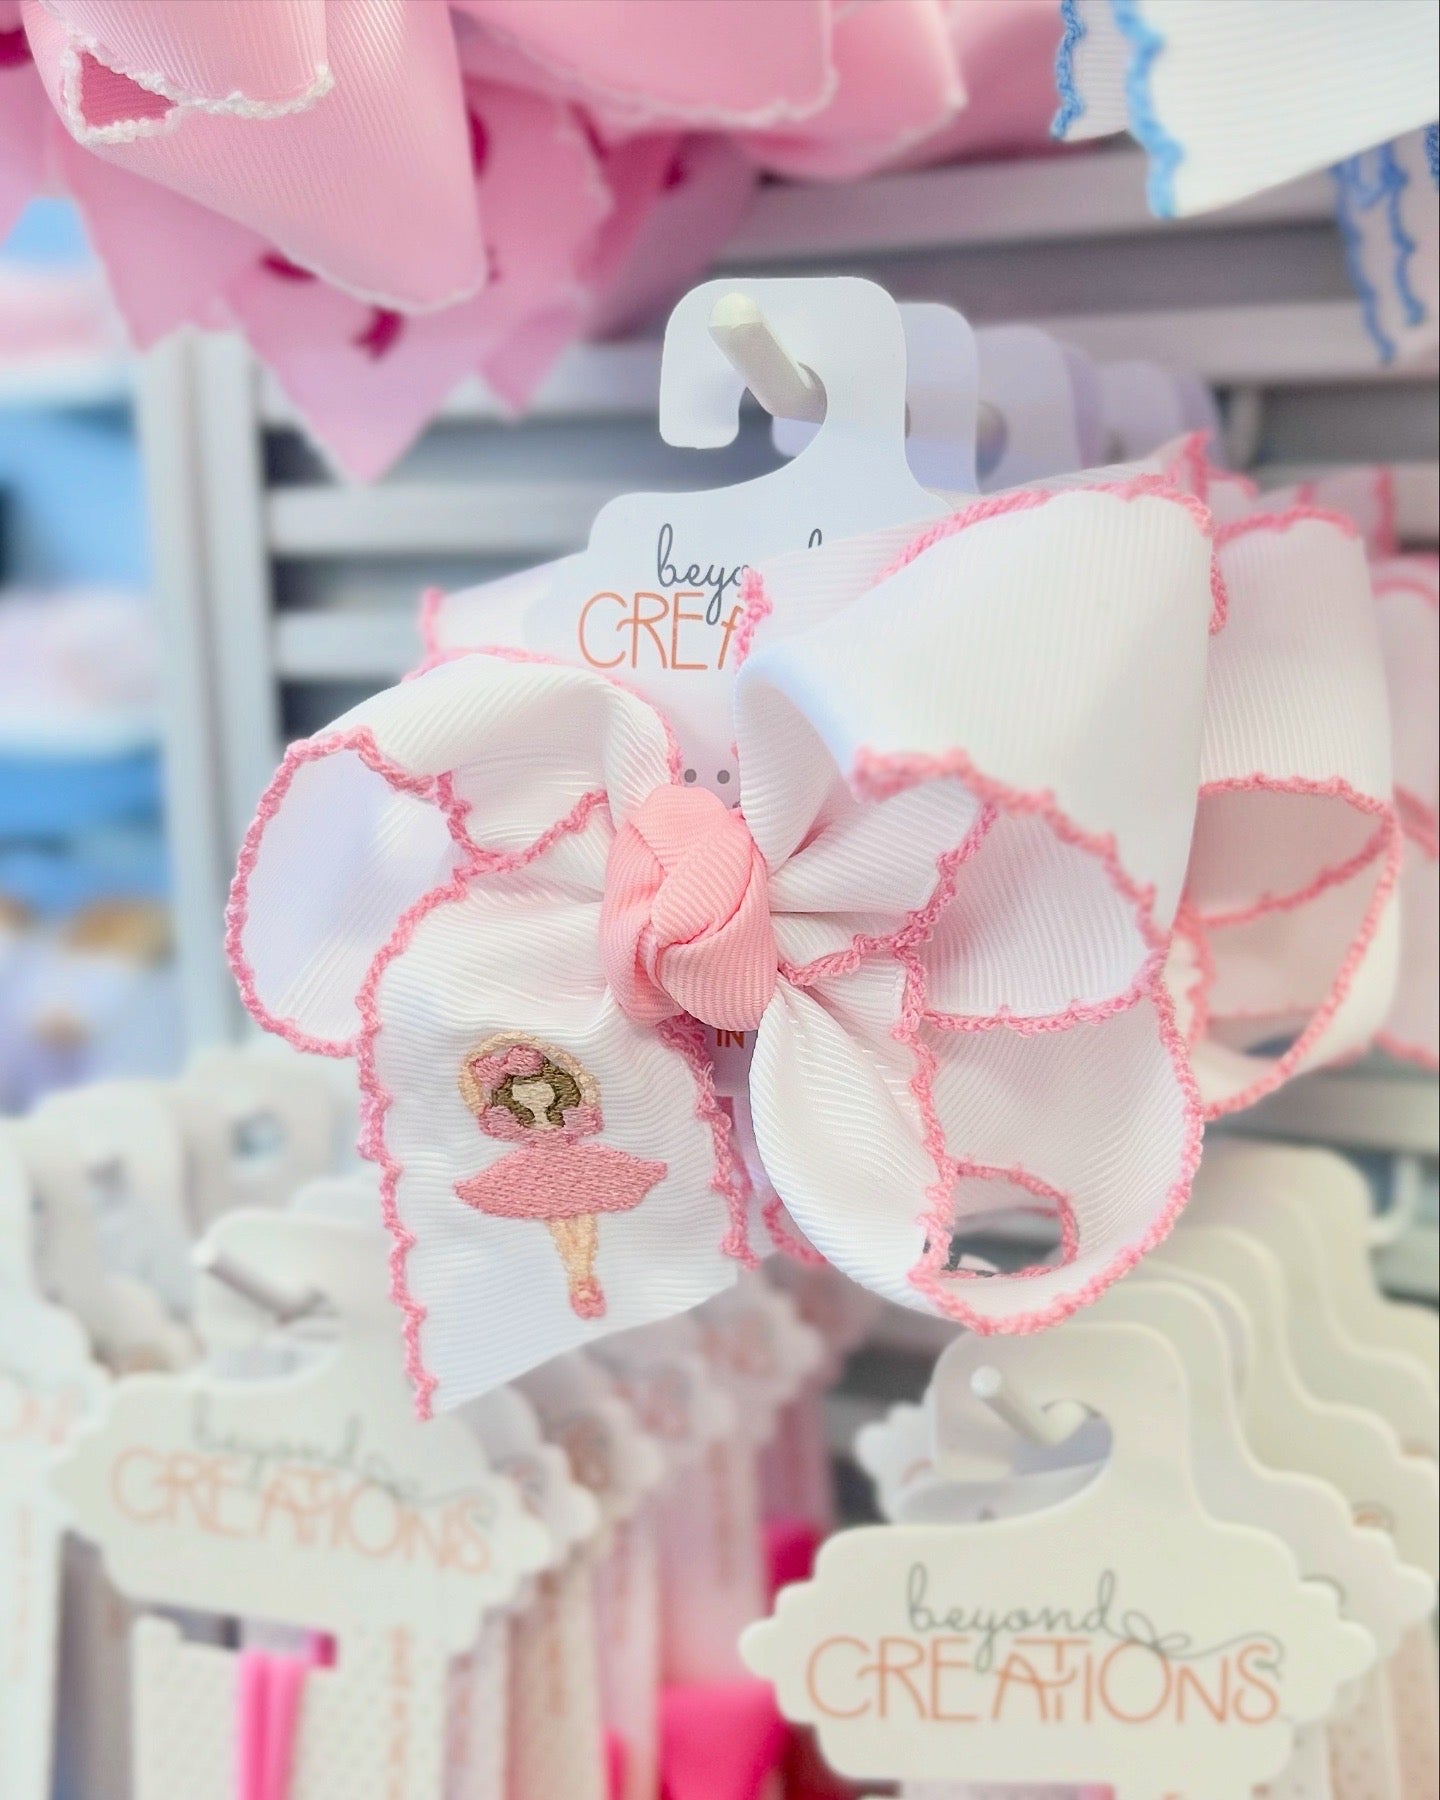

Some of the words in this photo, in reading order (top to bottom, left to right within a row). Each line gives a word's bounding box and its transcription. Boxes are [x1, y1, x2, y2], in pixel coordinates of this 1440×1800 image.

[656, 523, 823, 625] beyo
[108, 1445, 492, 1574] CREATIONS
[907, 1562, 1120, 1673] beyond
[806, 1635, 1280, 1725] CREATIONS
